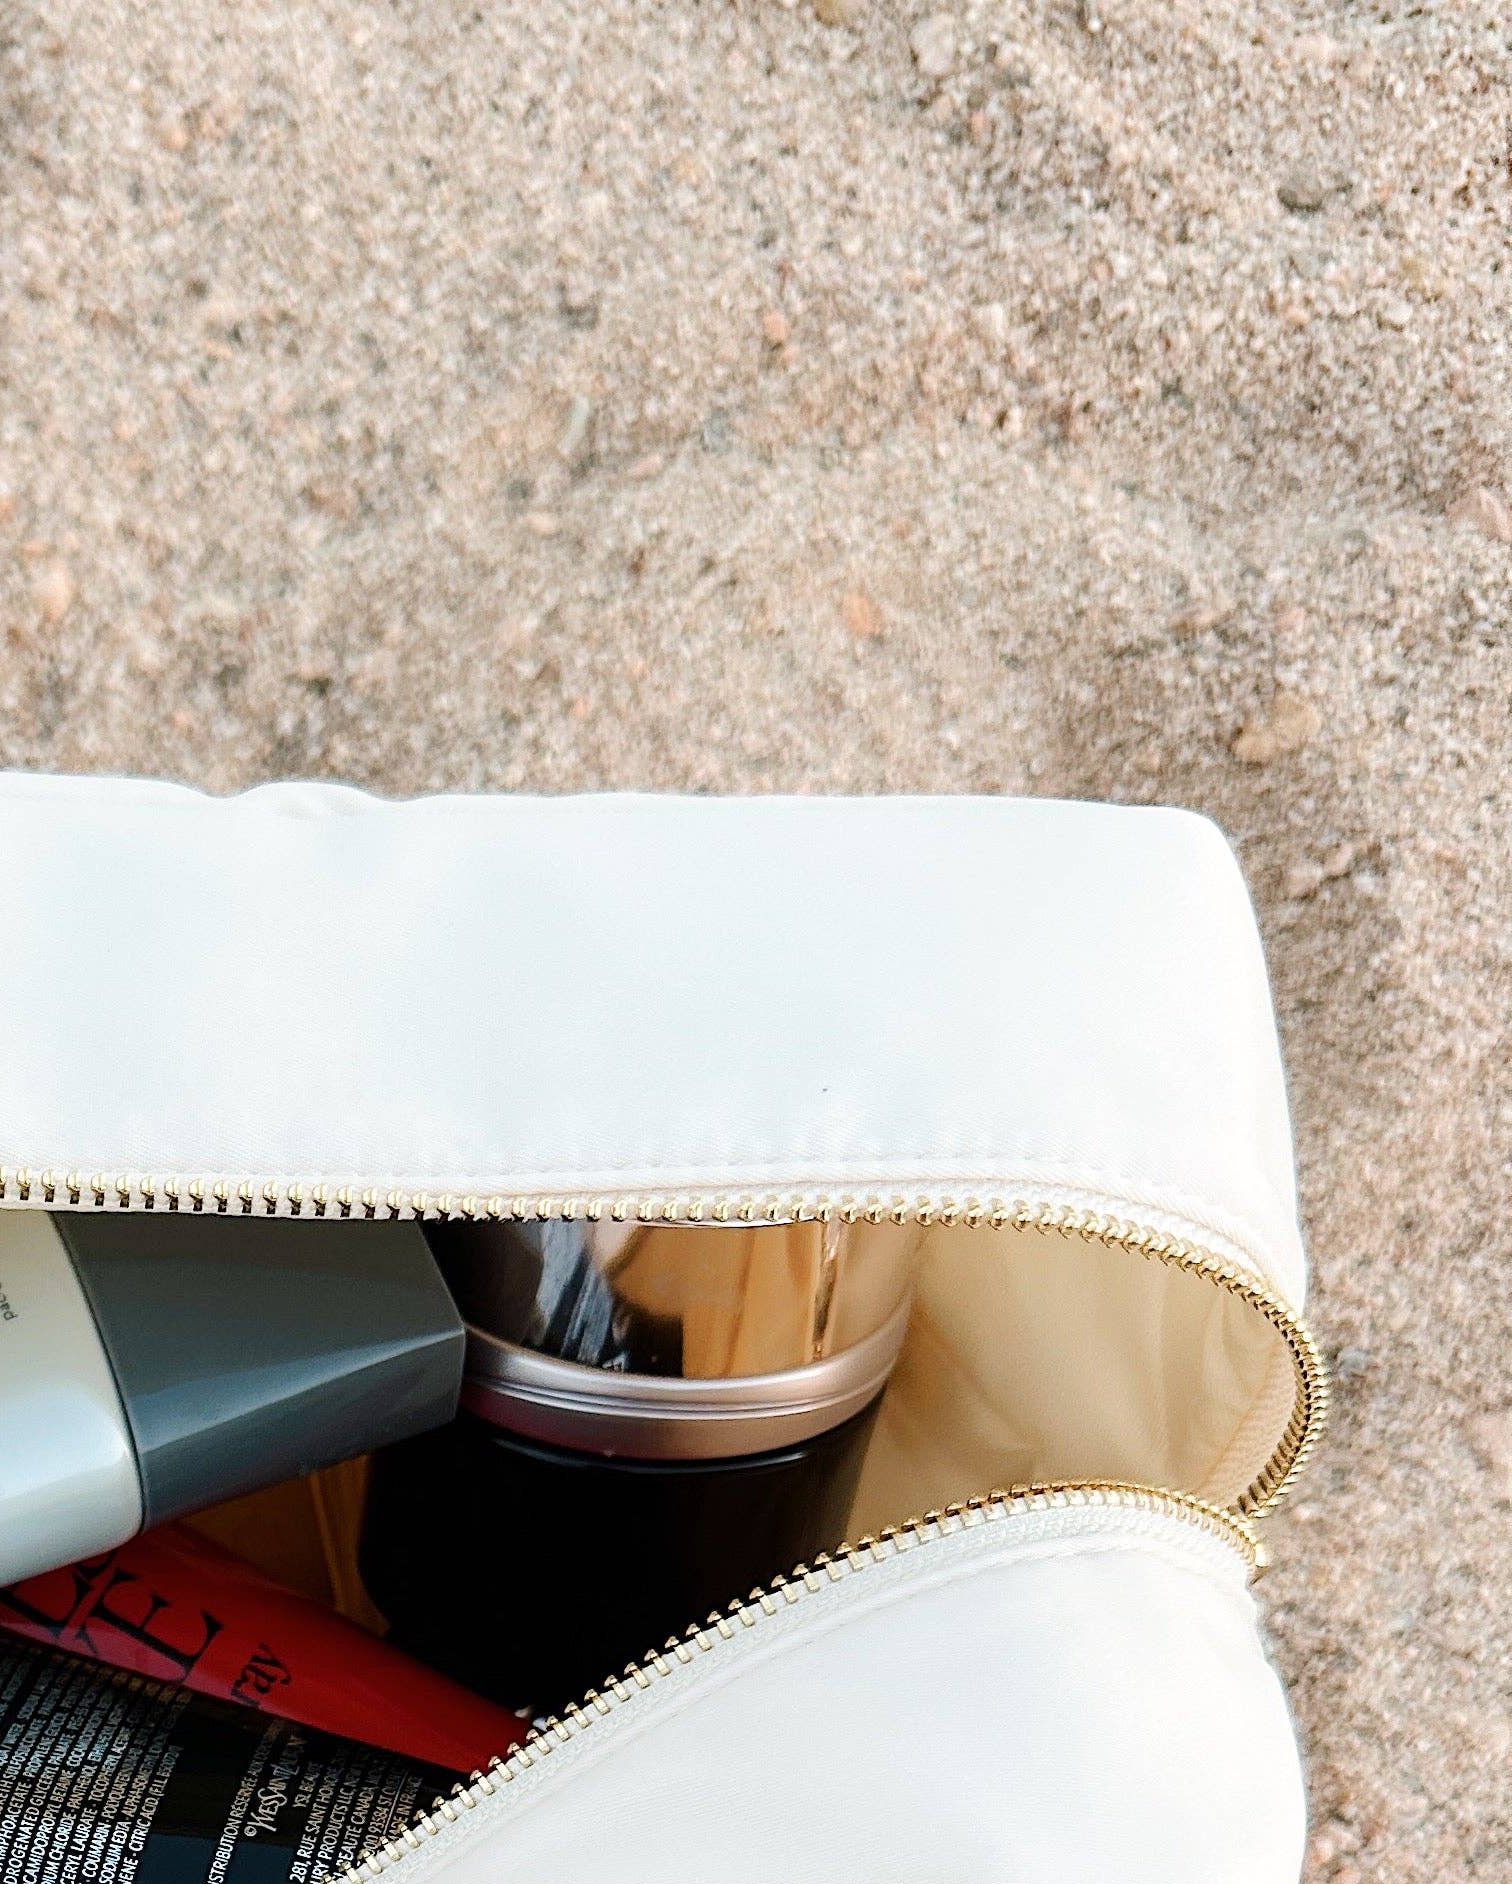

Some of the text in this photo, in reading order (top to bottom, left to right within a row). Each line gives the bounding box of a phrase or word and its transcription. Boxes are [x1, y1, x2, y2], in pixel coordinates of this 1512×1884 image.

[28, 1763, 58, 1806] GLYCERYL
[70, 1805, 97, 1852] LAURATE
[110, 1817, 131, 1844] EDTA
[316, 1803, 347, 1860] PRODUCTS
[395, 1803, 411, 1815] IN
[48, 1810, 76, 1861] CHLORIDE
[81, 1820, 111, 1878] COUMARIN
[127, 1817, 150, 1851] CITRIC
[290, 1802, 328, 1883] 281, RUE SAINT
